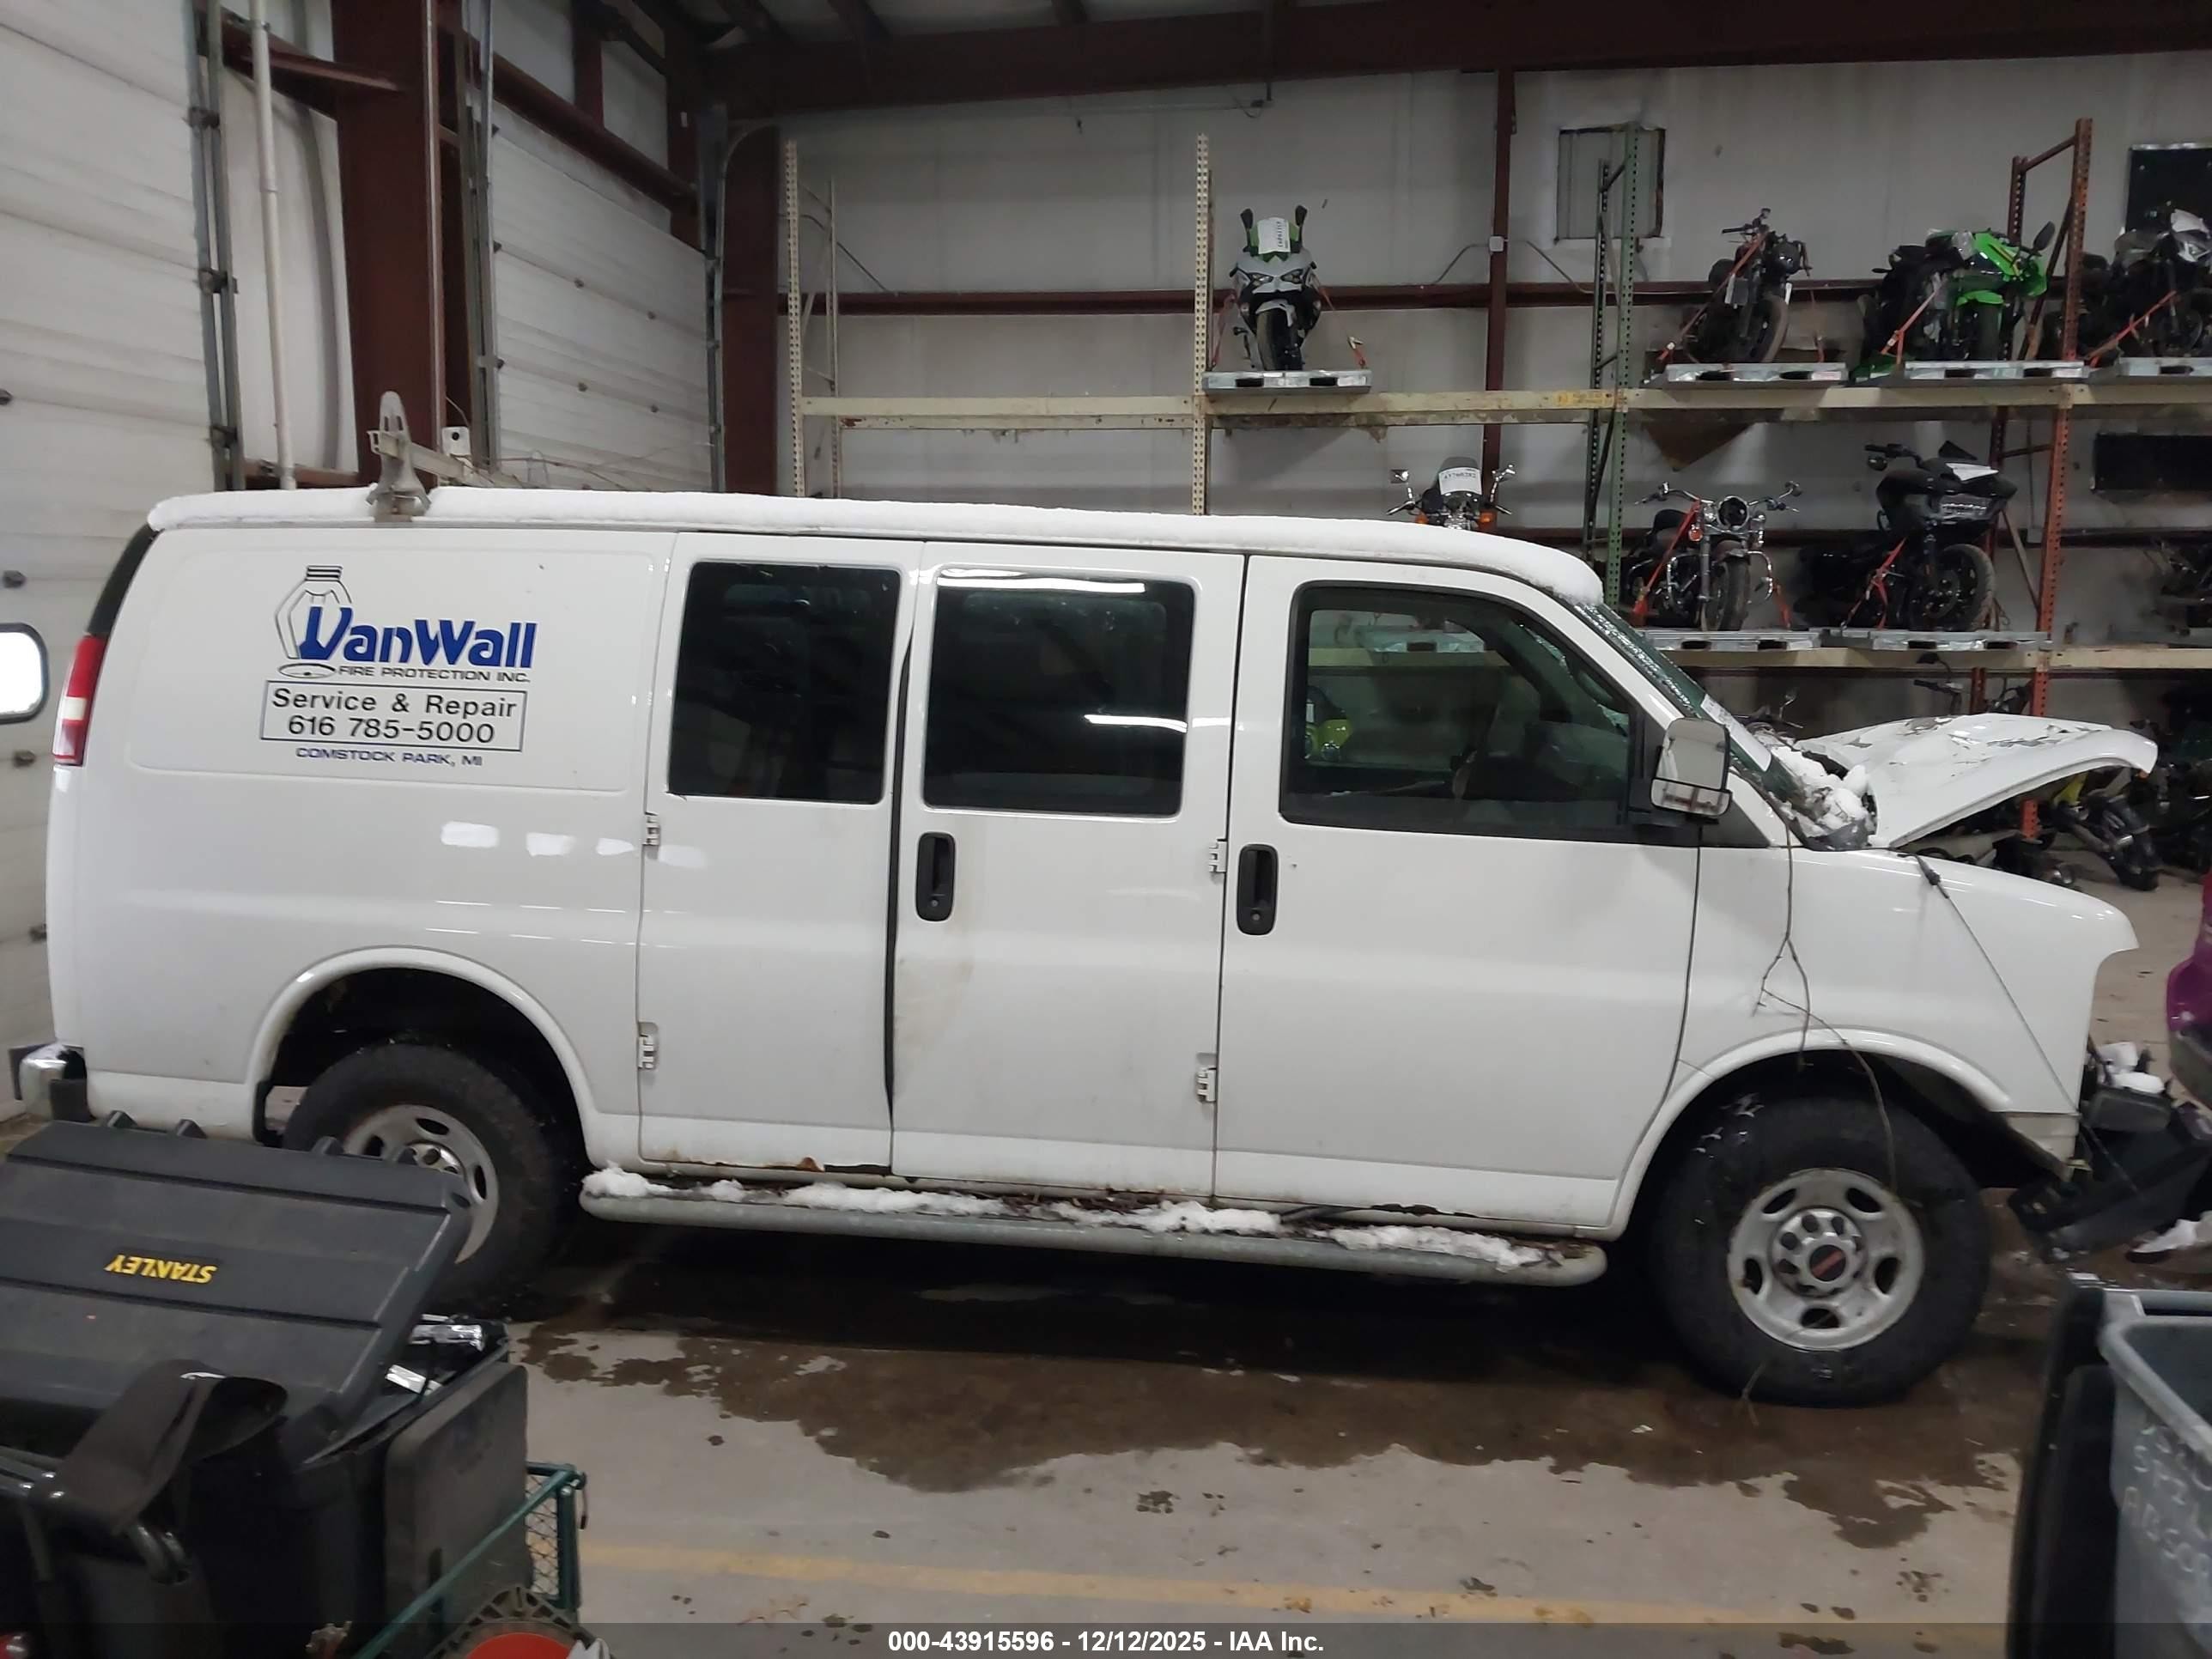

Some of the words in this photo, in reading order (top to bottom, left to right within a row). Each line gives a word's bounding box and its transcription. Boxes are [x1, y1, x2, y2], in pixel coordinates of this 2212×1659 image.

[298, 605, 538, 668] VanWall
[338, 665, 375, 677] FIRE
[380, 666, 491, 681] PROTECTION
[496, 672, 532, 683] INC.
[271, 688, 378, 712] Service
[391, 692, 410, 713] &
[425, 694, 518, 720] Repair
[288, 714, 336, 736] 616
[349, 717, 495, 744] 785-5000
[295, 748, 396, 763] COMSTOCK
[401, 752, 456, 767] PARK,
[461, 756, 483, 766] MI
[103, 1254, 218, 1284] STANLEY
